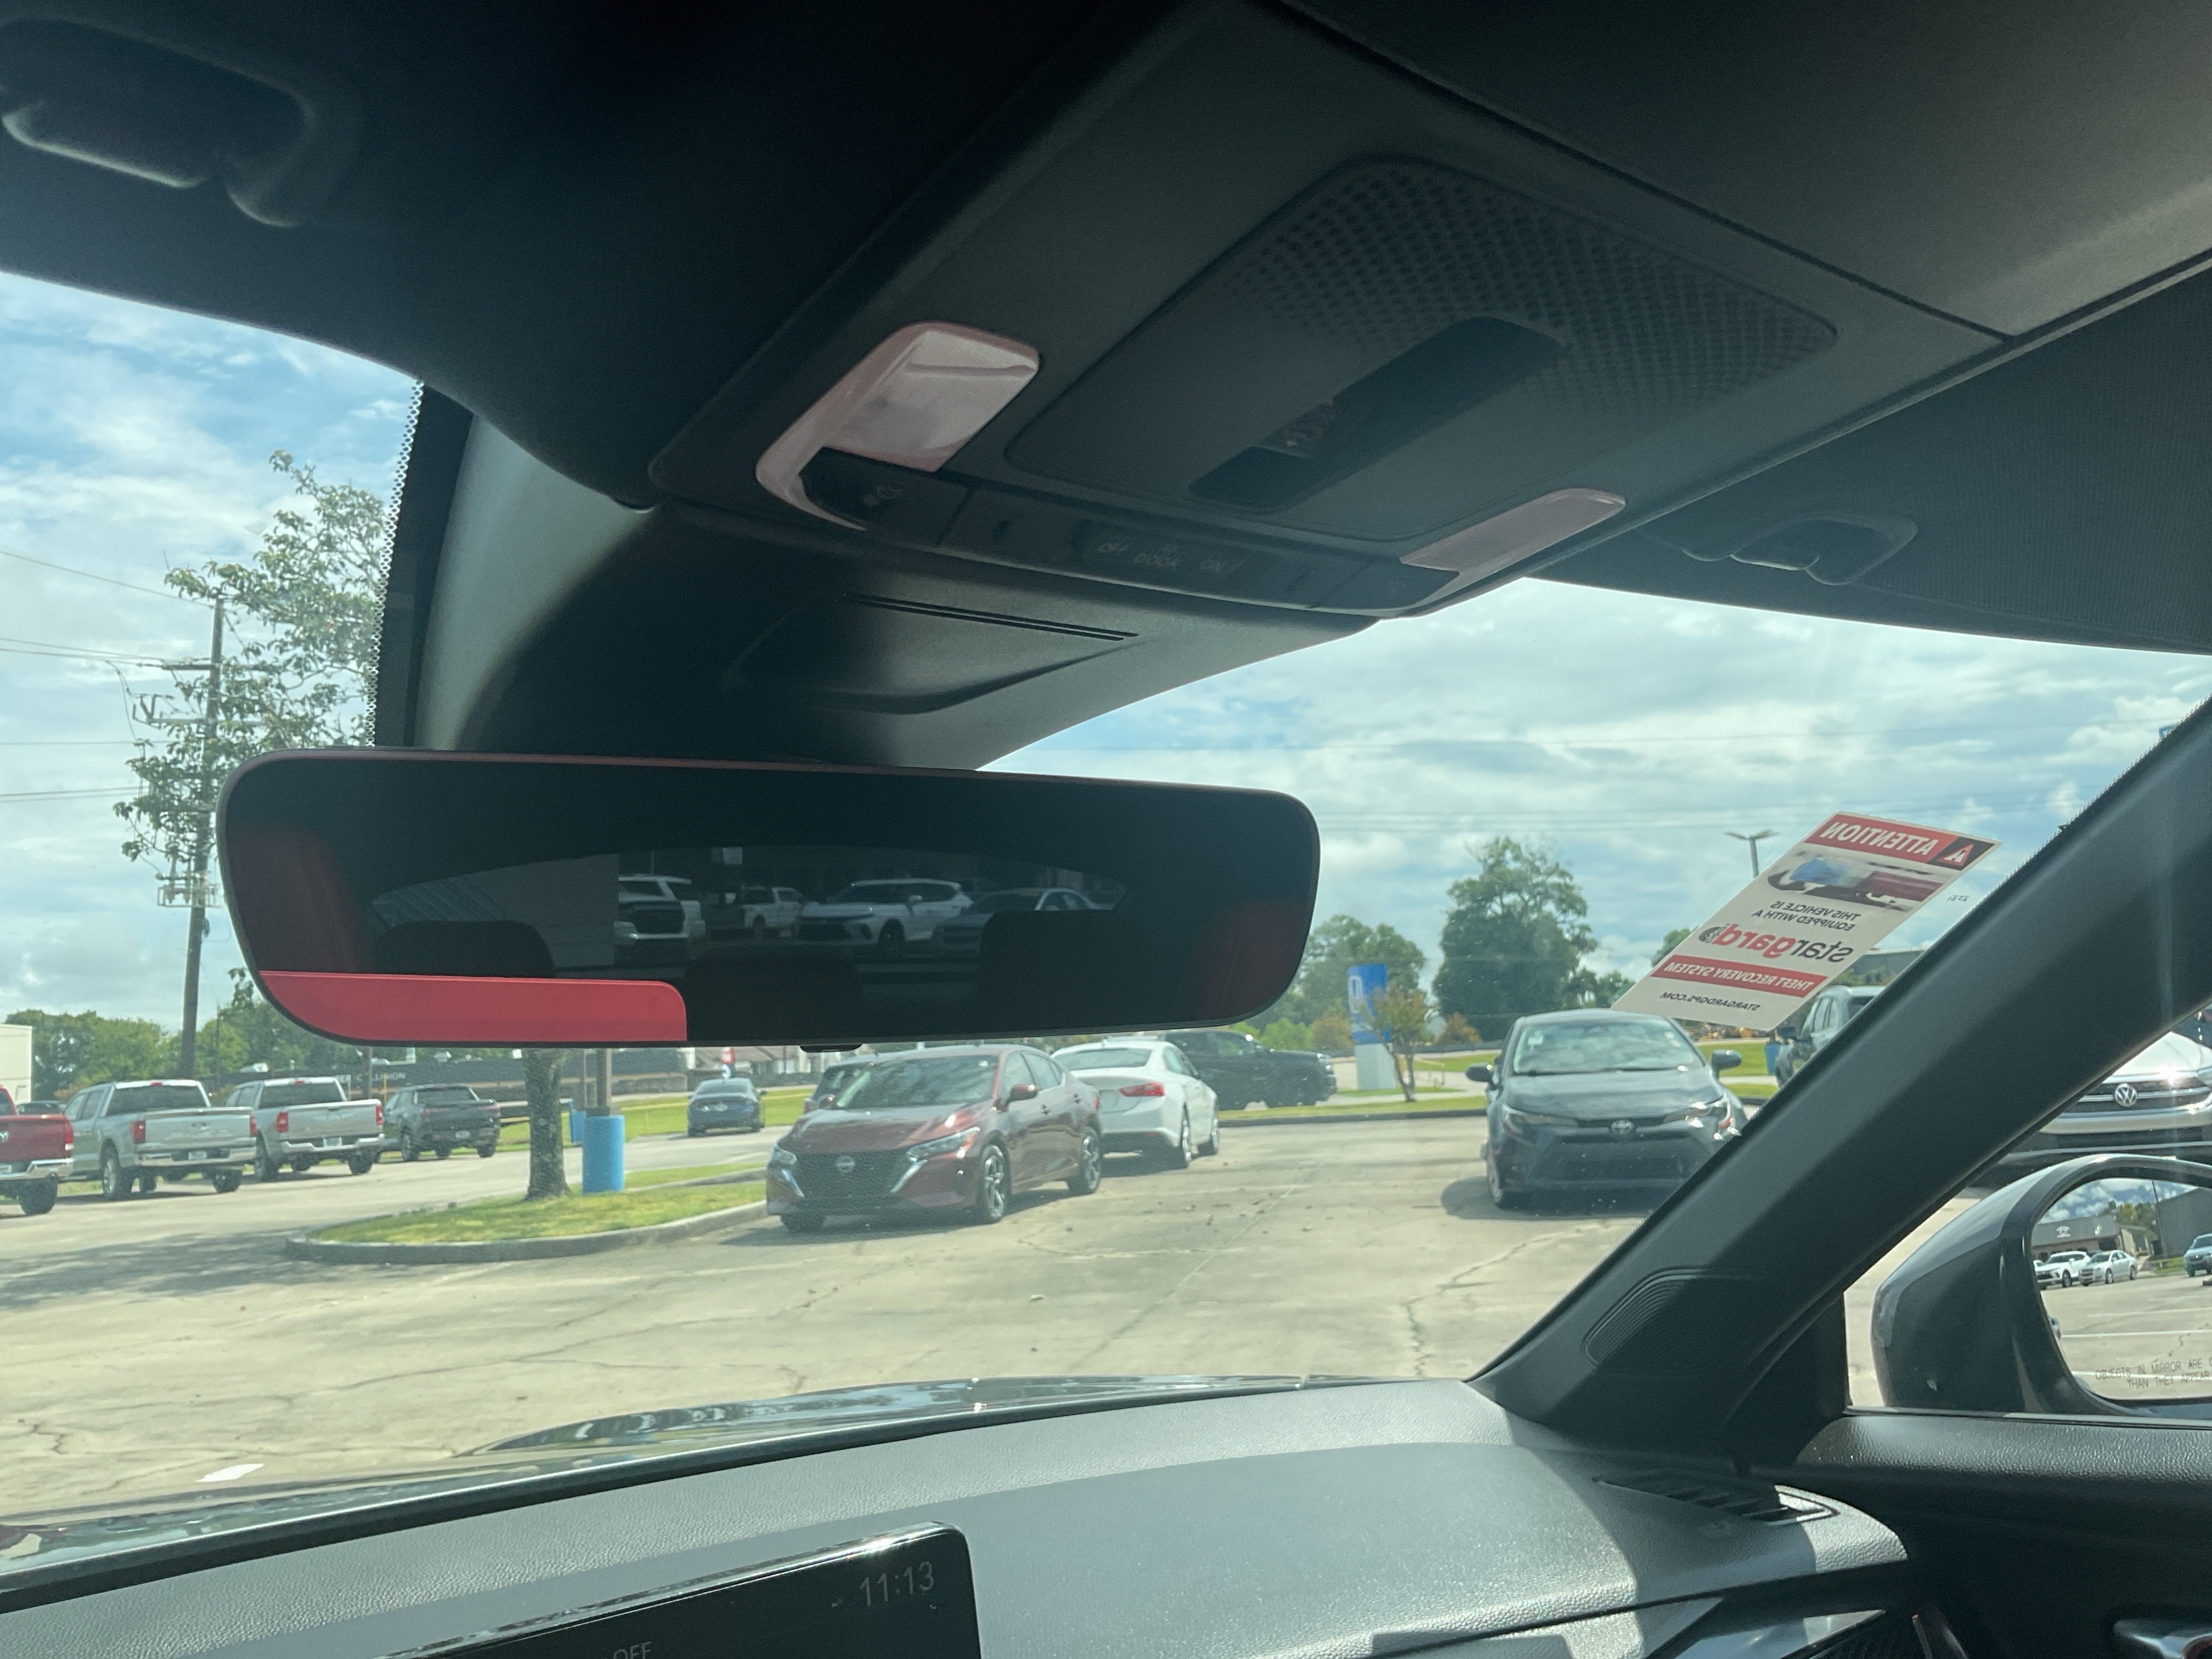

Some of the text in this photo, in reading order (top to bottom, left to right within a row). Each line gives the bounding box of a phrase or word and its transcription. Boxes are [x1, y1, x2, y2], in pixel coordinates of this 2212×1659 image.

[2095, 1366, 2131, 1380] OBJECTS
[2137, 1364, 2146, 1374] IN
[2151, 1361, 2181, 1374] MIRROR
[2188, 1358, 2203, 1369] ARE
[2127, 1370, 2210, 1389] THAN THEY APPEAR
[860, 1561, 934, 1606] 11:13
